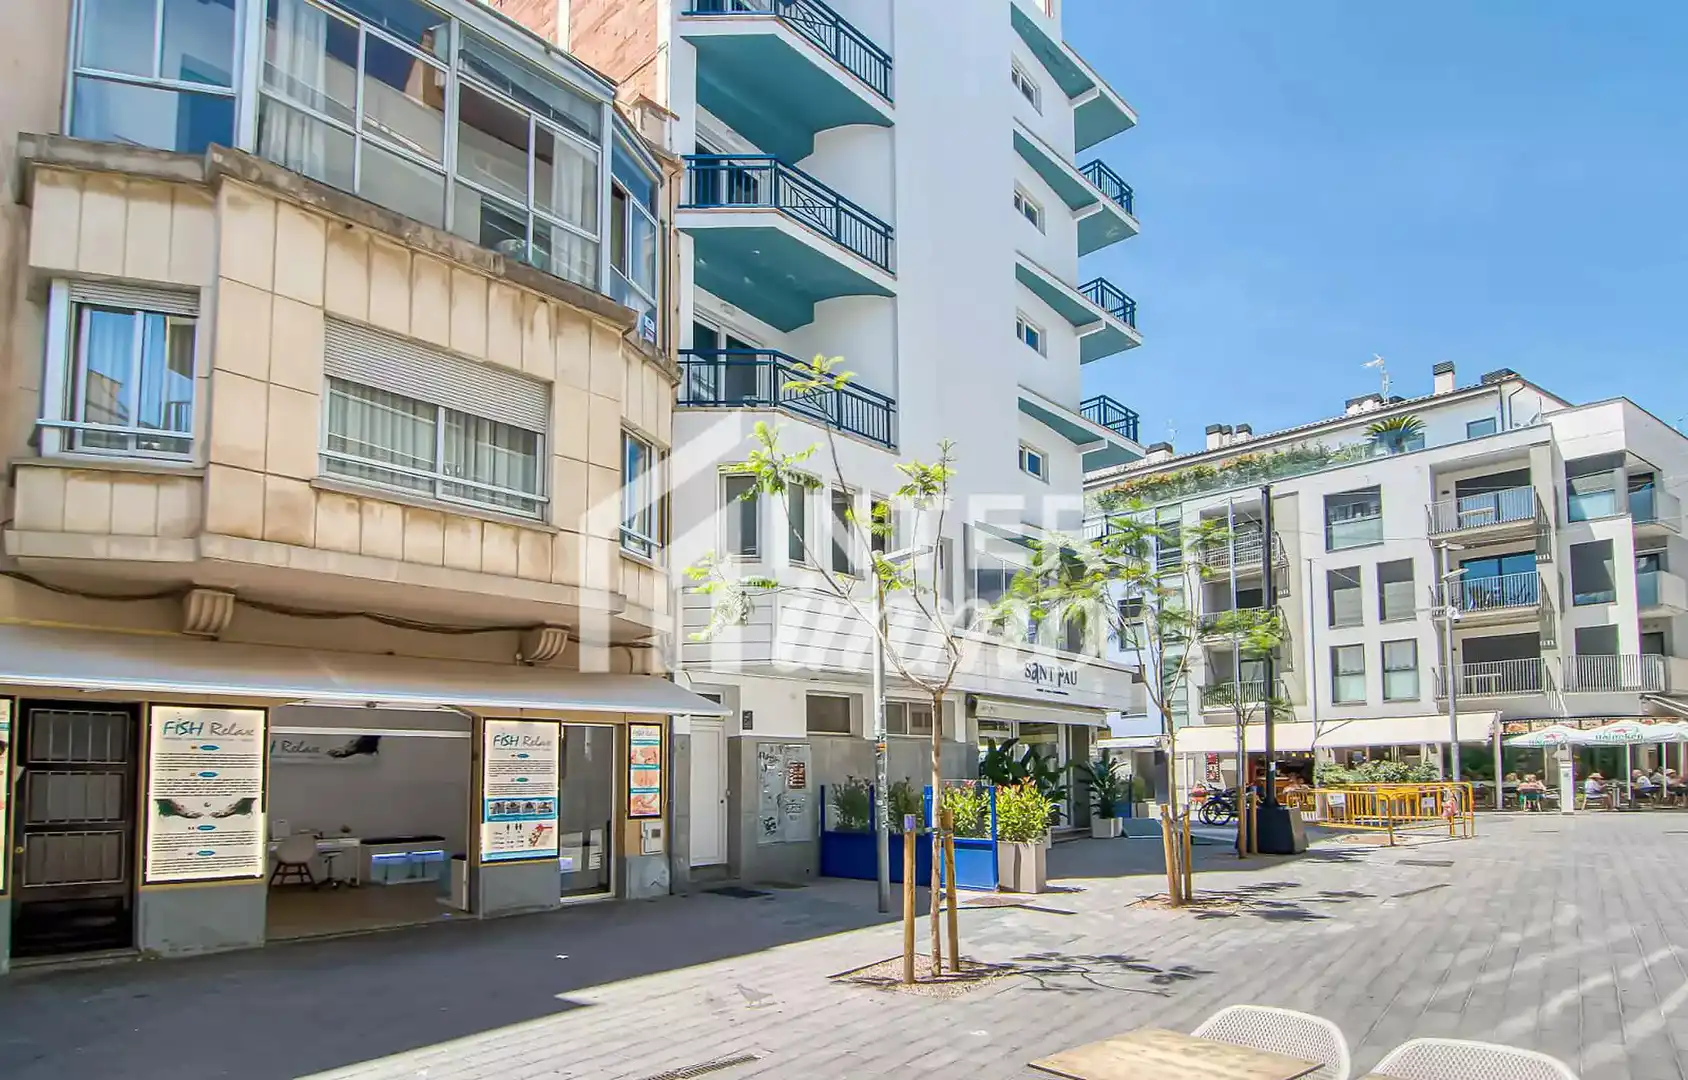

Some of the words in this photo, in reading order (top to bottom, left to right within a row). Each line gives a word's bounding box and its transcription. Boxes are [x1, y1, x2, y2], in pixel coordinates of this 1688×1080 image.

[1058, 665, 1078, 687] PAU
[210, 721, 254, 737] Relax
[523, 735, 552, 747] Relax
